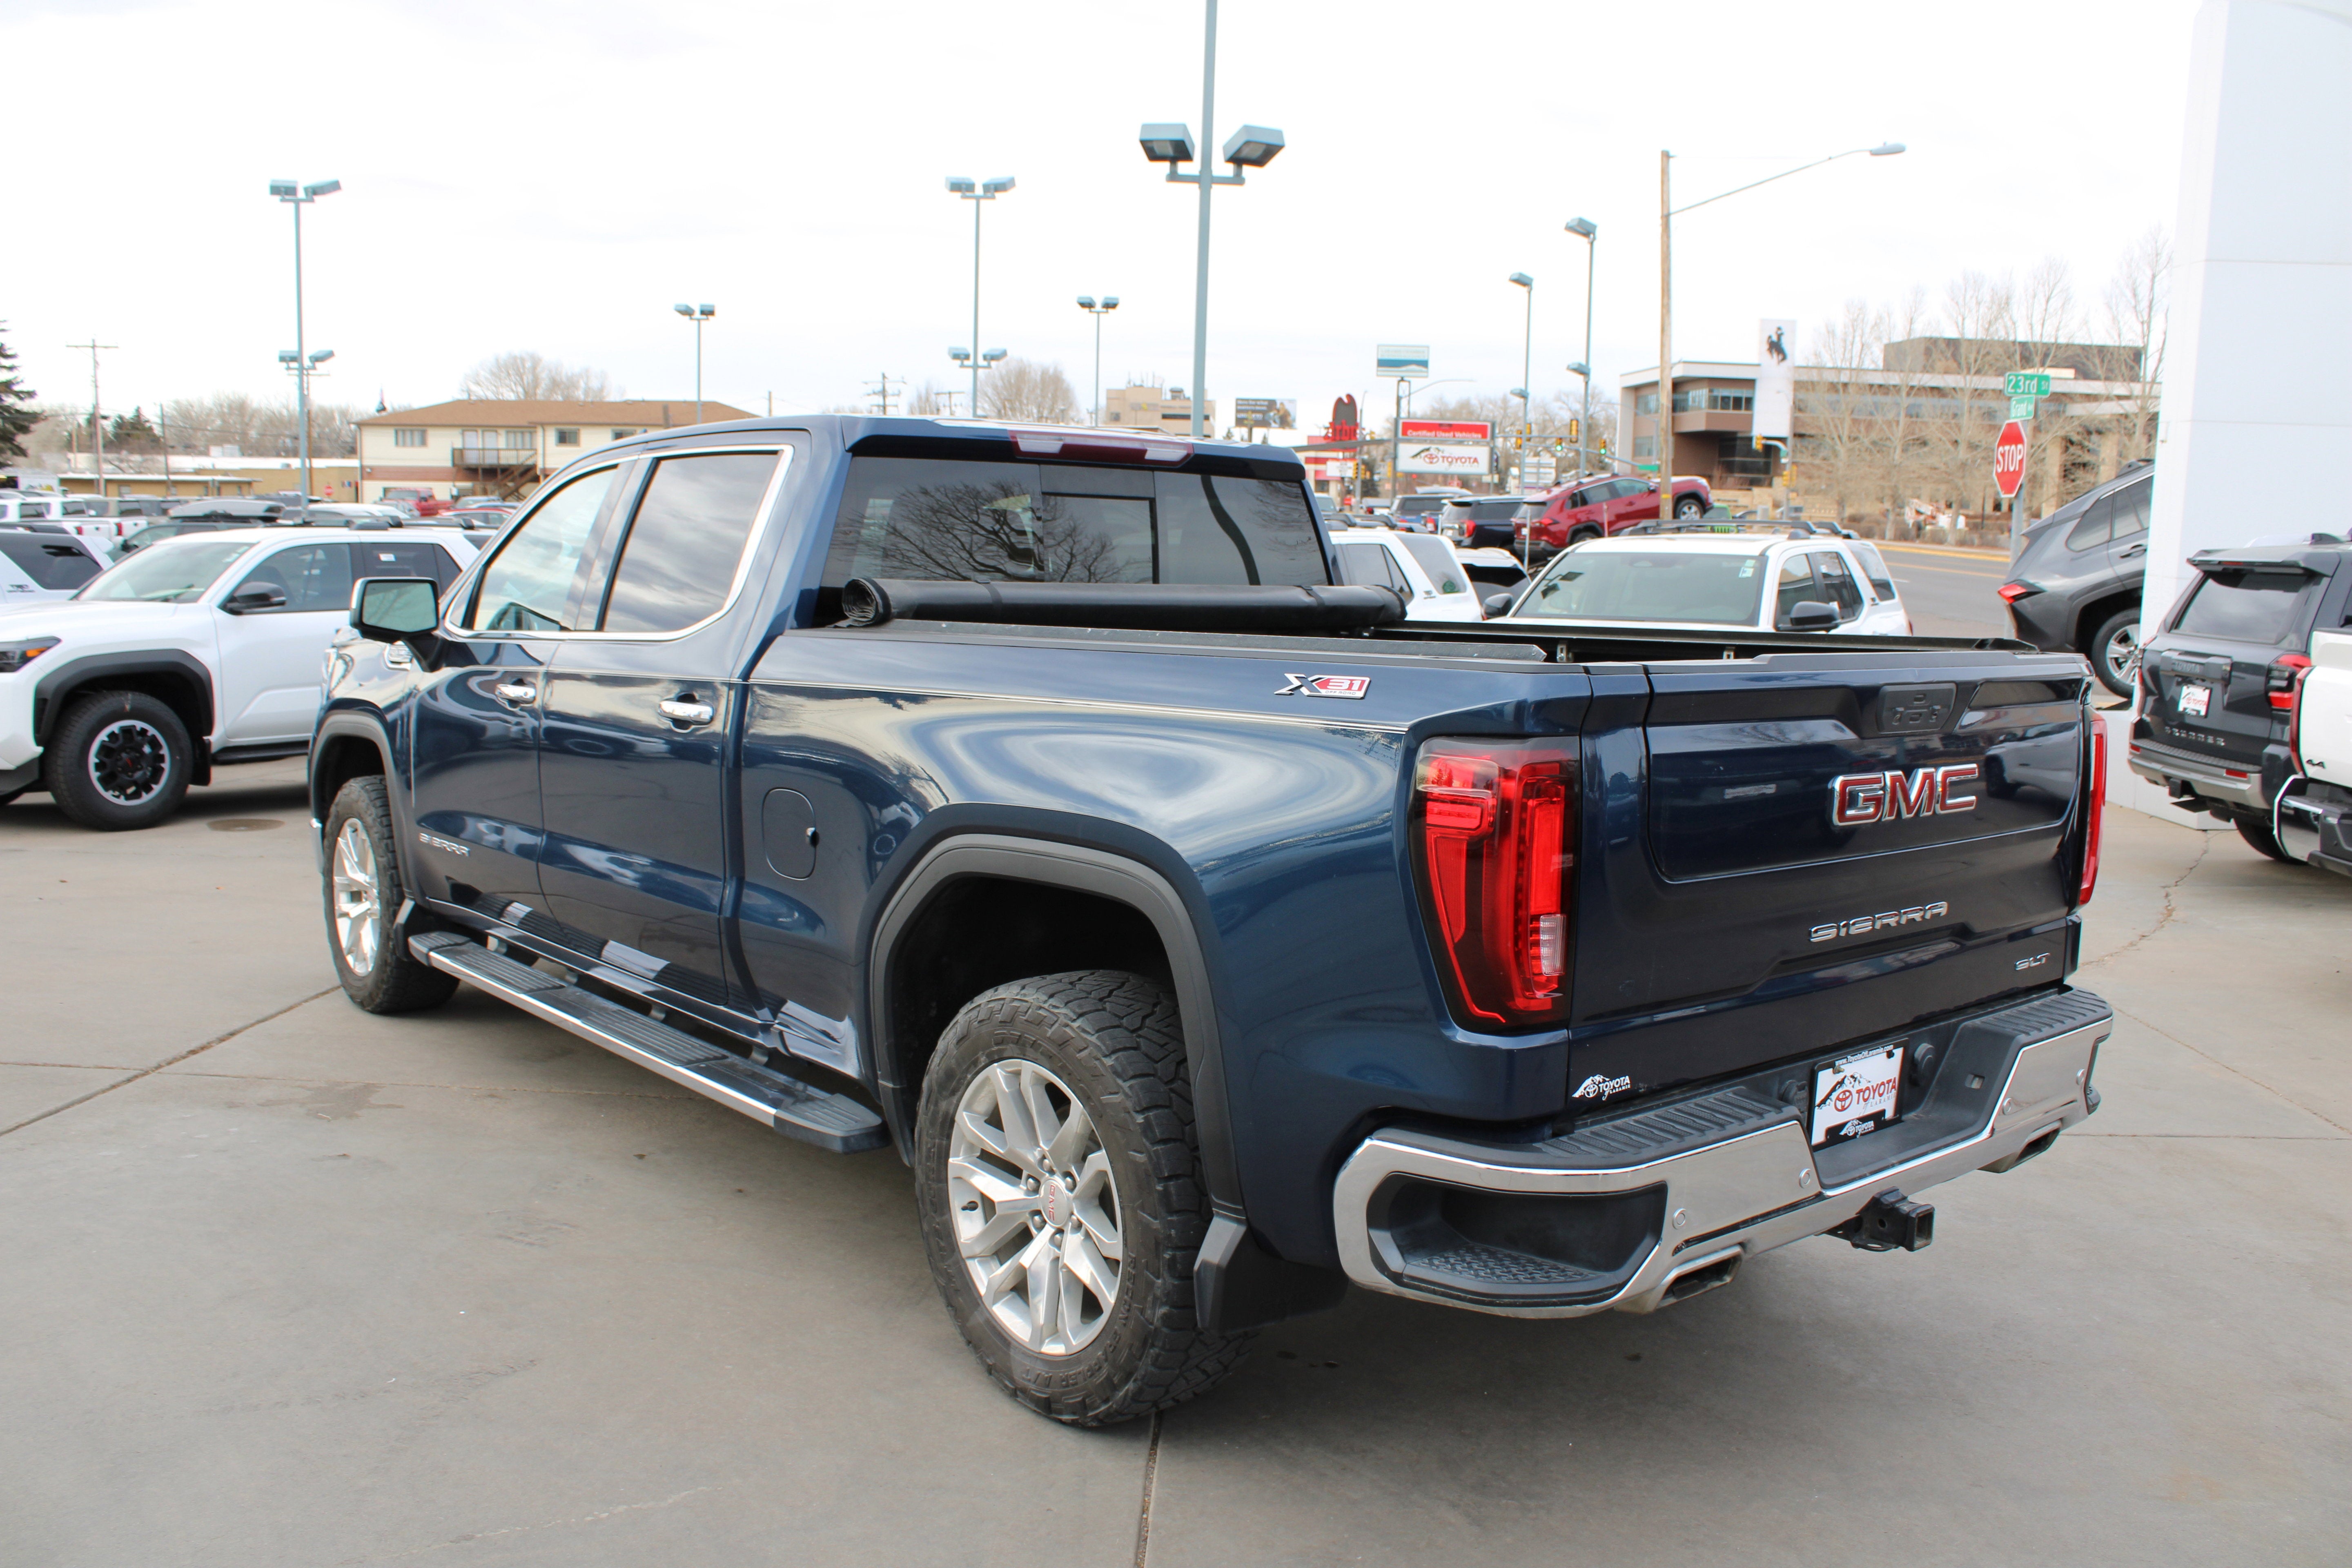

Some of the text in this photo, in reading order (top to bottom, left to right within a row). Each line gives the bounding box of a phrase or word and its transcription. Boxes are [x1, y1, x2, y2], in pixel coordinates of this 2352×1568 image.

[2008, 375, 2037, 393] 23rd
[2012, 401, 2027, 417] Grand
[1441, 456, 1479, 464] TOYOTA
[1996, 444, 2023, 473] STOP
[1829, 763, 1979, 826] GMC
[419, 832, 470, 857] SIERRA
[1809, 900, 1949, 942] SIERRA
[2015, 952, 2050, 970] SLT
[1599, 1076, 1630, 1093] TOYOTA
[1610, 1084, 1631, 1094] LARAMIE
[1855, 1077, 1897, 1105] TOYOTA
[1855, 1120, 1874, 1132] TOYOTA
